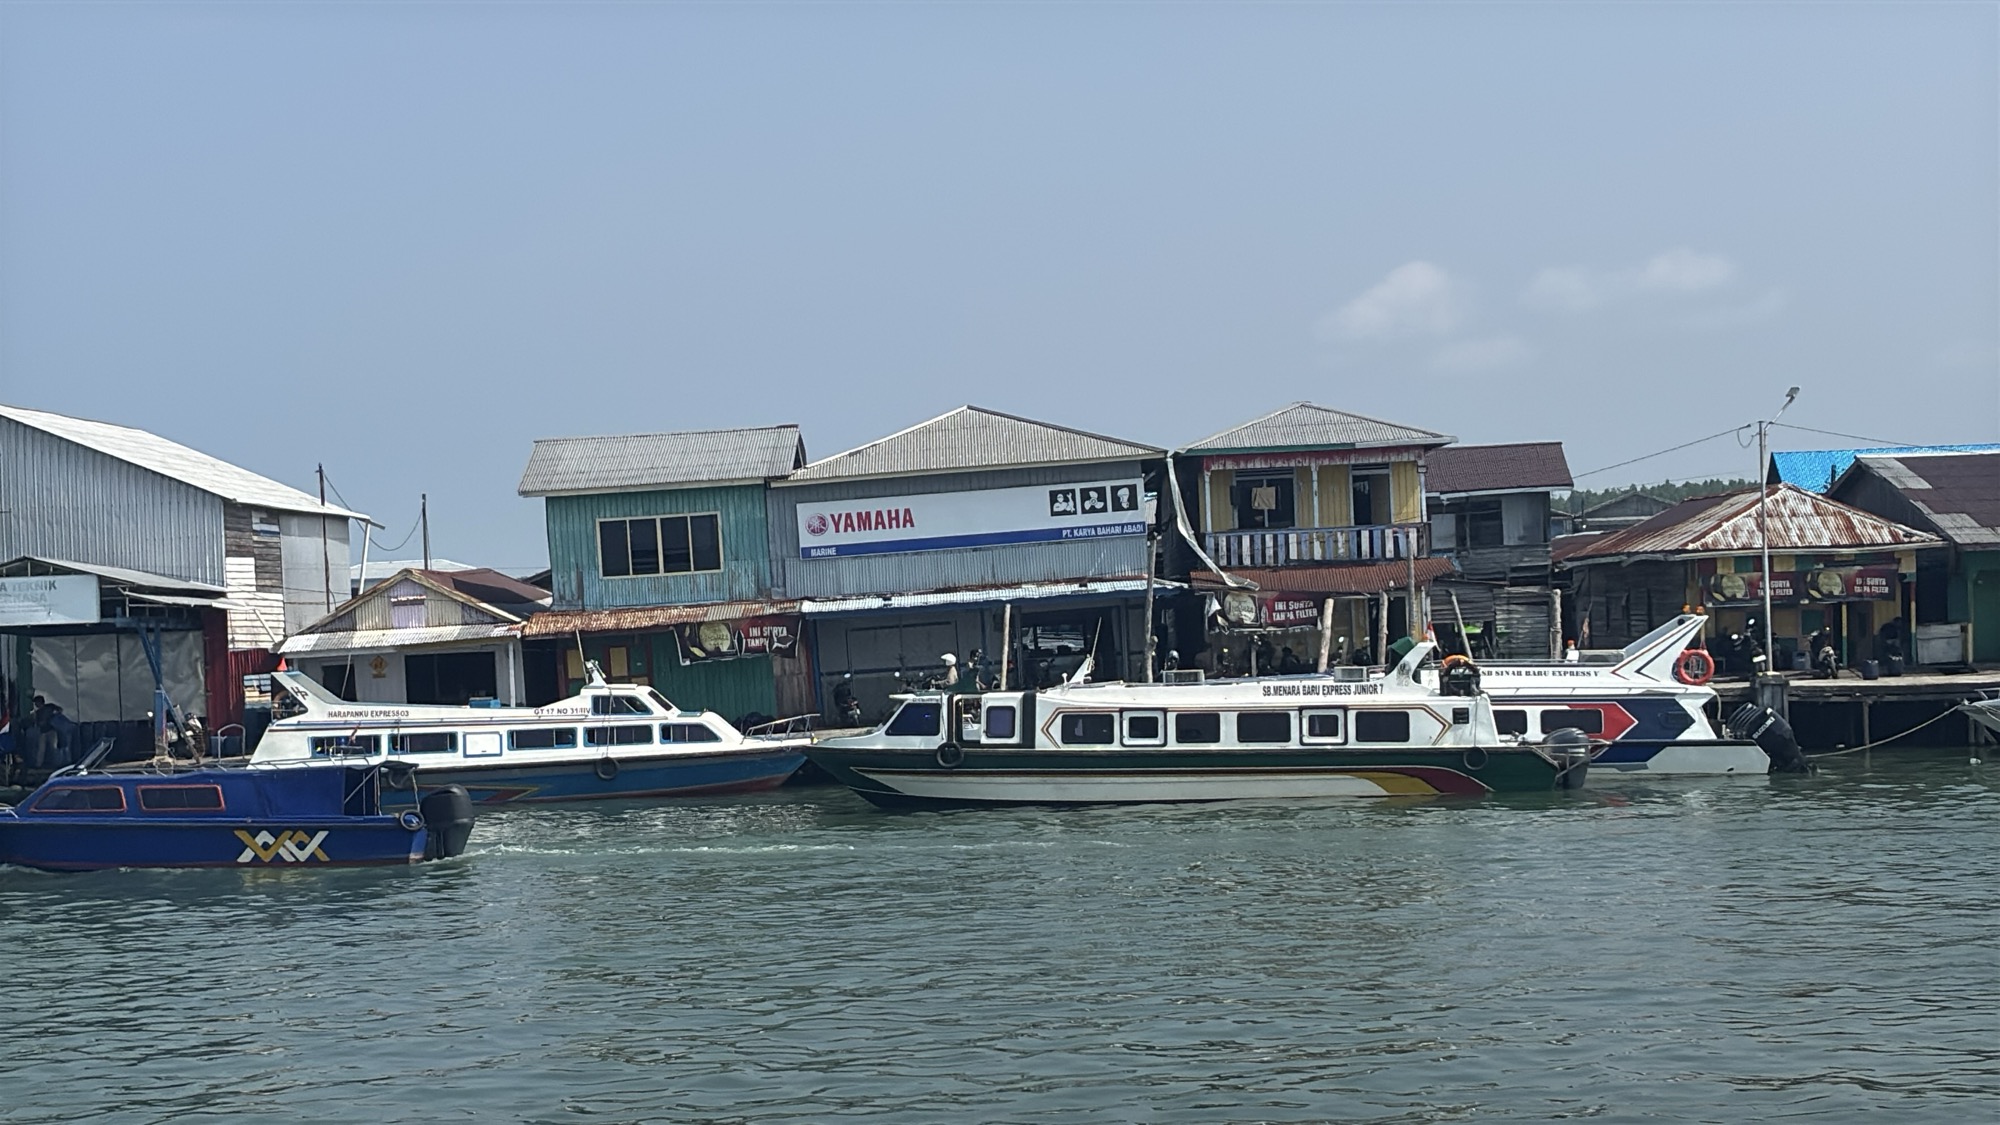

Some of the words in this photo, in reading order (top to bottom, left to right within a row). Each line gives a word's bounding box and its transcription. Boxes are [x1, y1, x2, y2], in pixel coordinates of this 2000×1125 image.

[830, 508, 915, 533] YAMAHA
[1062, 529, 1072, 538] PT.
[1073, 527, 1096, 537] KARYA
[1097, 525, 1122, 535] BAHARI
[1123, 523, 1144, 533] ABADI
[810, 547, 837, 557] MARINE
[13, 580, 57, 592] TEKNIK
[1296, 608, 1318, 619] FILTER
[749, 627, 761, 637] INI
[1302, 684, 1320, 696] BARU
[1322, 684, 1352, 696] EXPRESS
[1353, 683, 1378, 695] JUNIOR
[1379, 683, 1384, 695] 7
[328, 710, 369, 718] HARAPANKU
